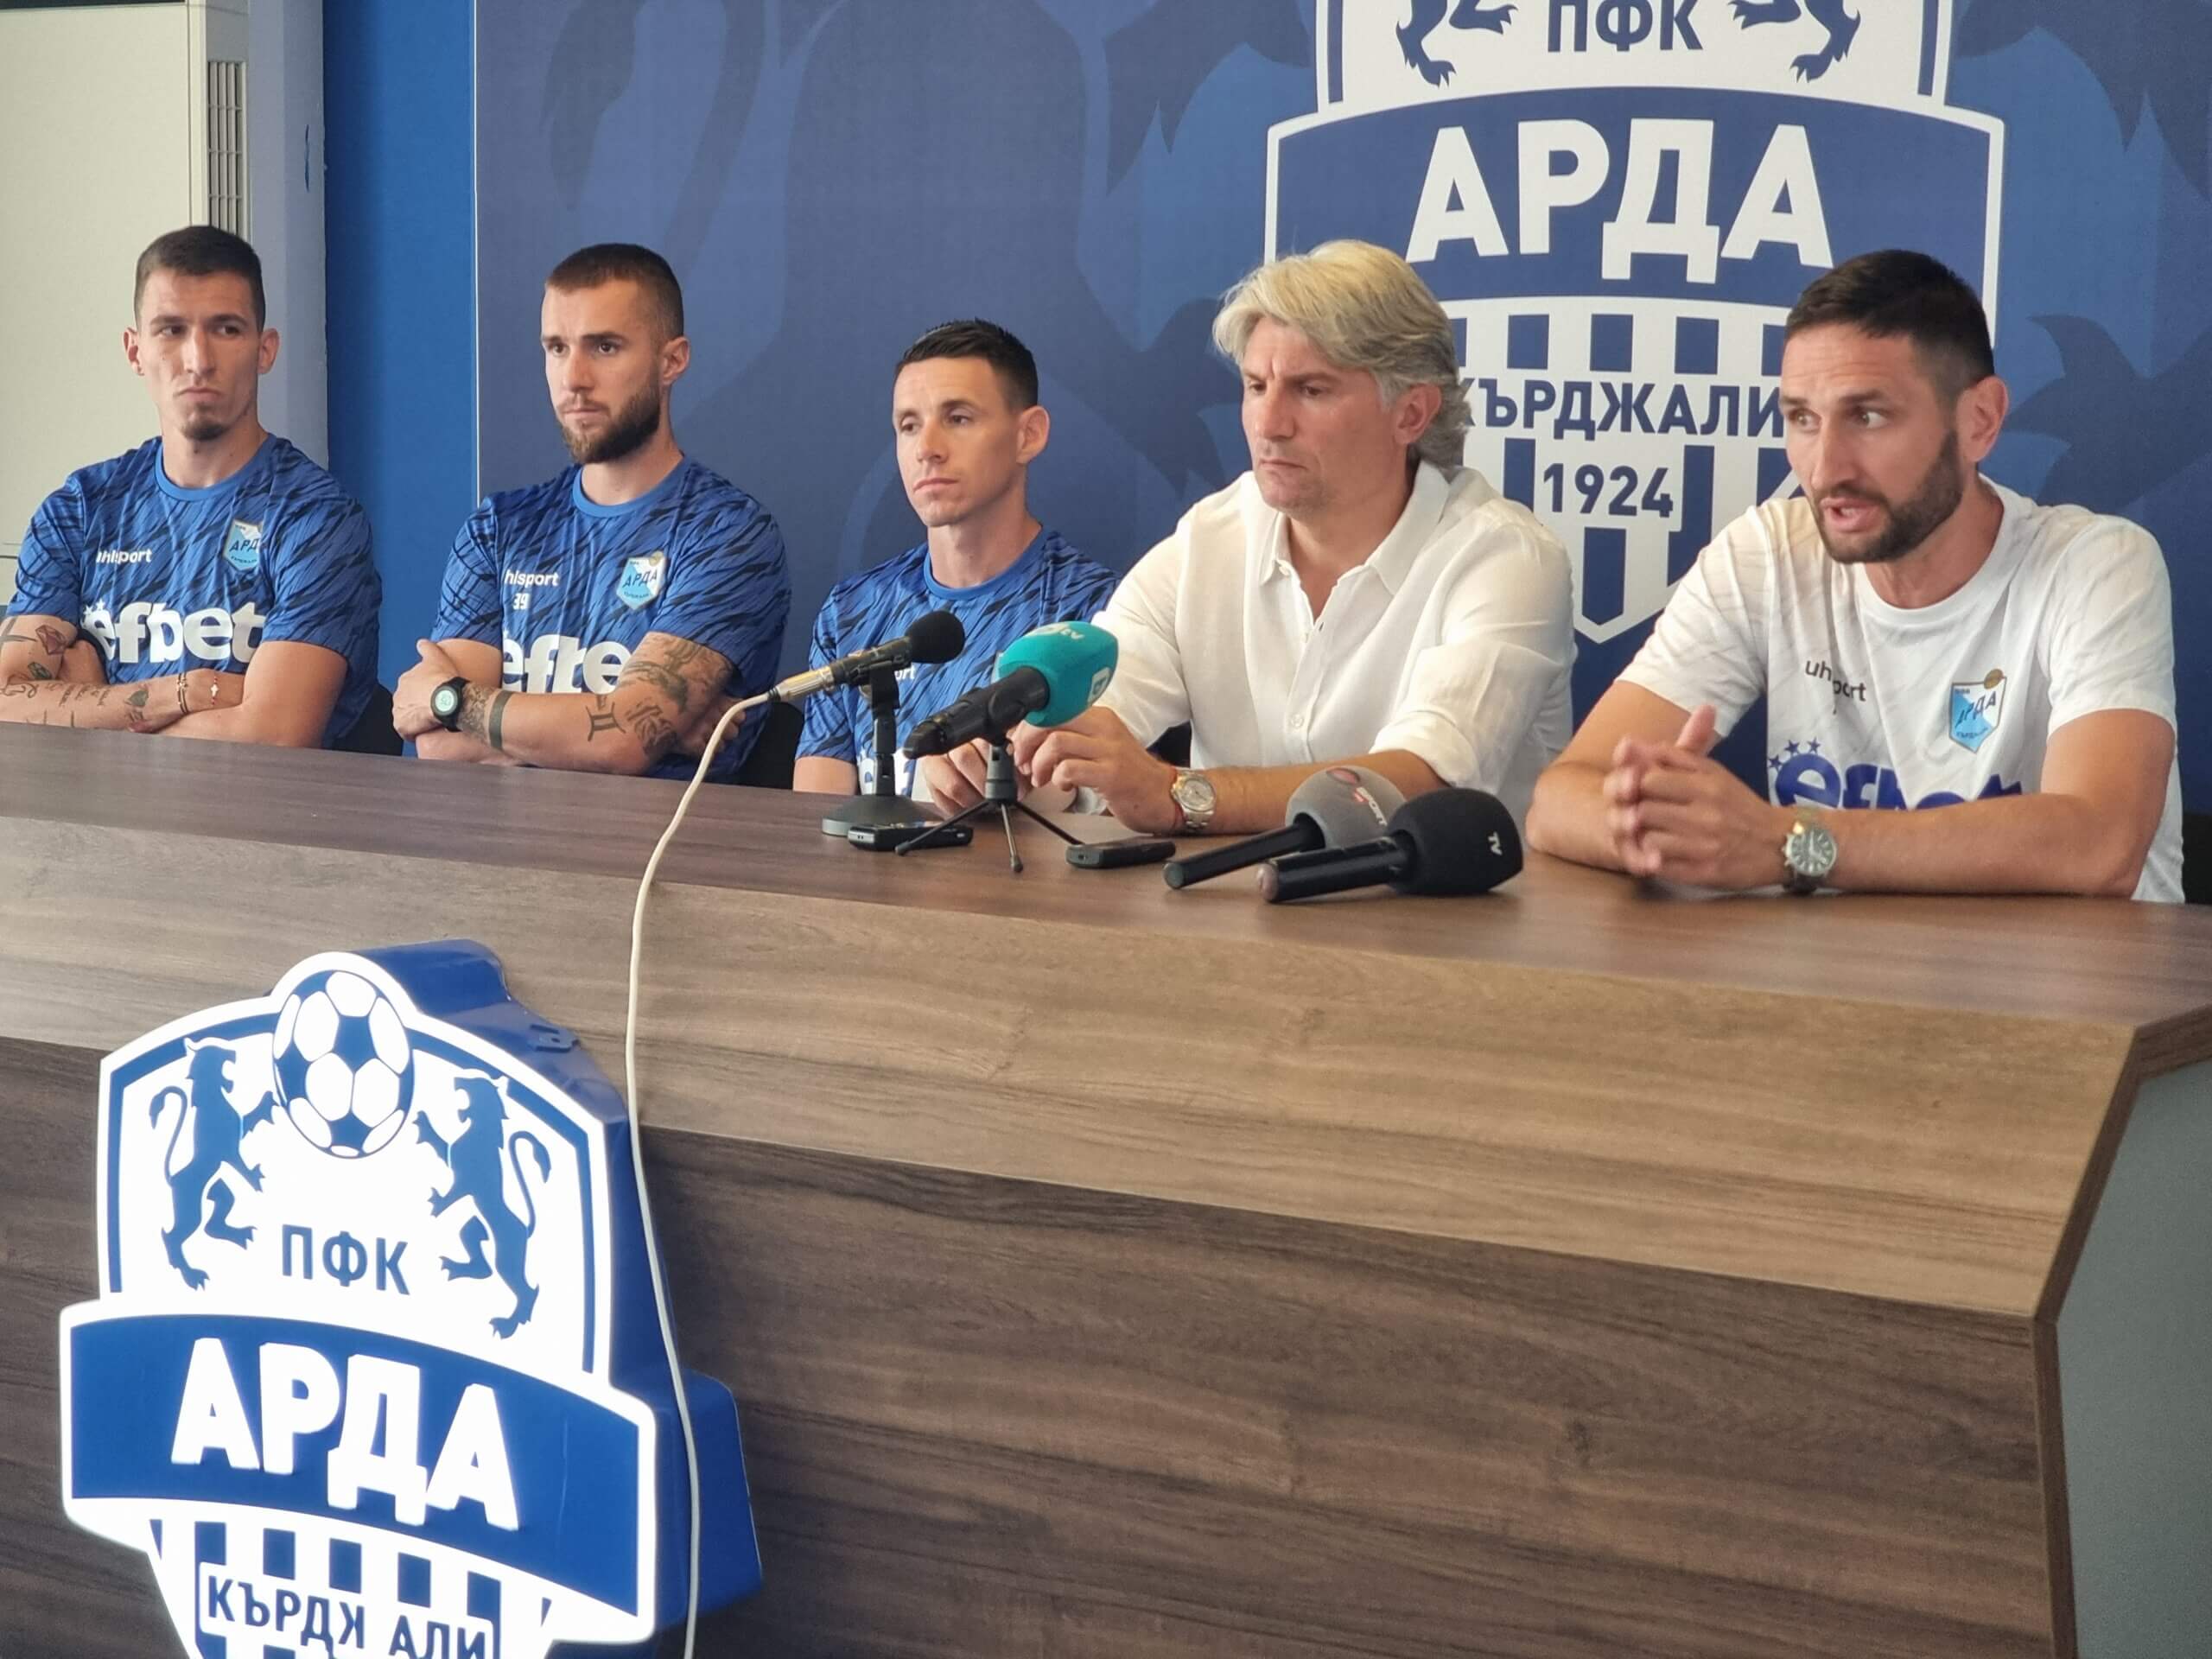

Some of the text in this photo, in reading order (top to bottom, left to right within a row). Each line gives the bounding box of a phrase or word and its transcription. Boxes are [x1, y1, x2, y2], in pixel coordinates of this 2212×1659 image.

[1548, 0, 1703, 53] ПФК
[1405, 118, 1833, 283] АРДА
[1543, 462, 1674, 518] 1924
[228, 539, 262, 553] АРД
[504, 569, 560, 588] hlsport
[512, 592, 531, 610] 39
[80, 601, 265, 664] efbet
[1487, 830, 1503, 856] TV
[281, 1224, 410, 1295] ПФК
[169, 1337, 520, 1532] АРДА
